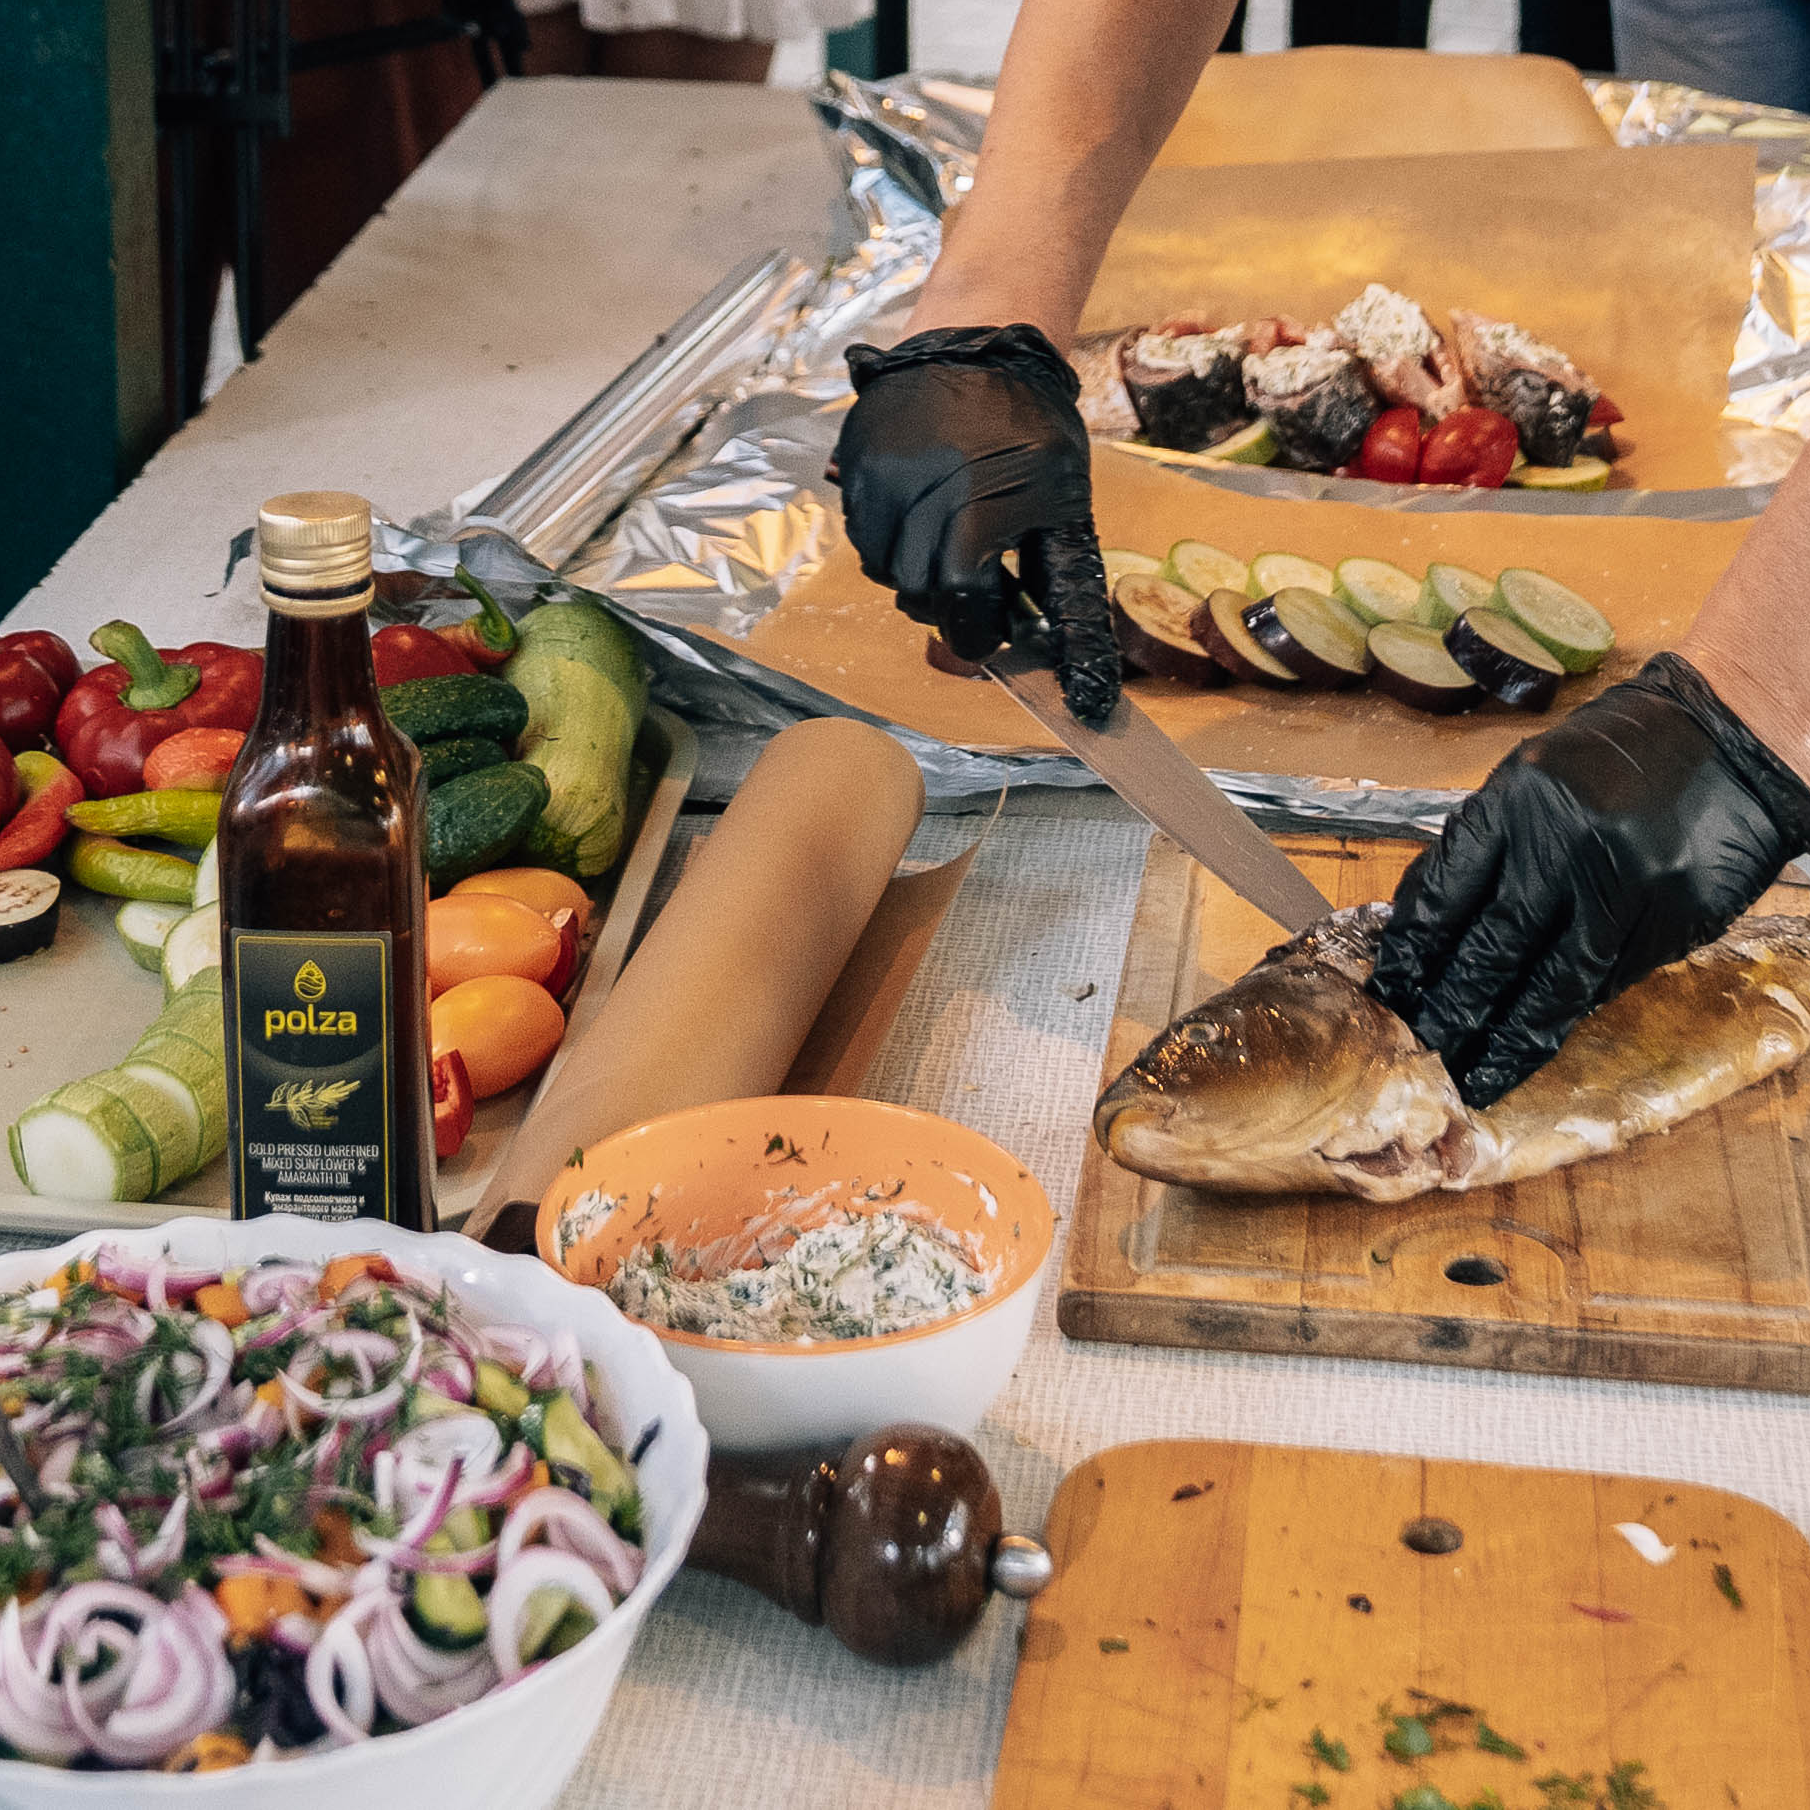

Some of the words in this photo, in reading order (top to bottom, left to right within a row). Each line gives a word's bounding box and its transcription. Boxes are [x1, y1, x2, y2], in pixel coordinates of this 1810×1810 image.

[265, 1003, 358, 1040] polza
[249, 1142, 275, 1156] COLD
[277, 1143, 322, 1157] PRESSED
[324, 1144, 379, 1158] UNREFINED
[262, 1157, 293, 1170] MIXED
[294, 1157, 355, 1171] SUNFLOWER
[357, 1158, 366, 1171] &
[277, 1171, 333, 1184] AMARANTH
[335, 1173, 351, 1185] OIL
[264, 1190, 292, 1203] Купаж
